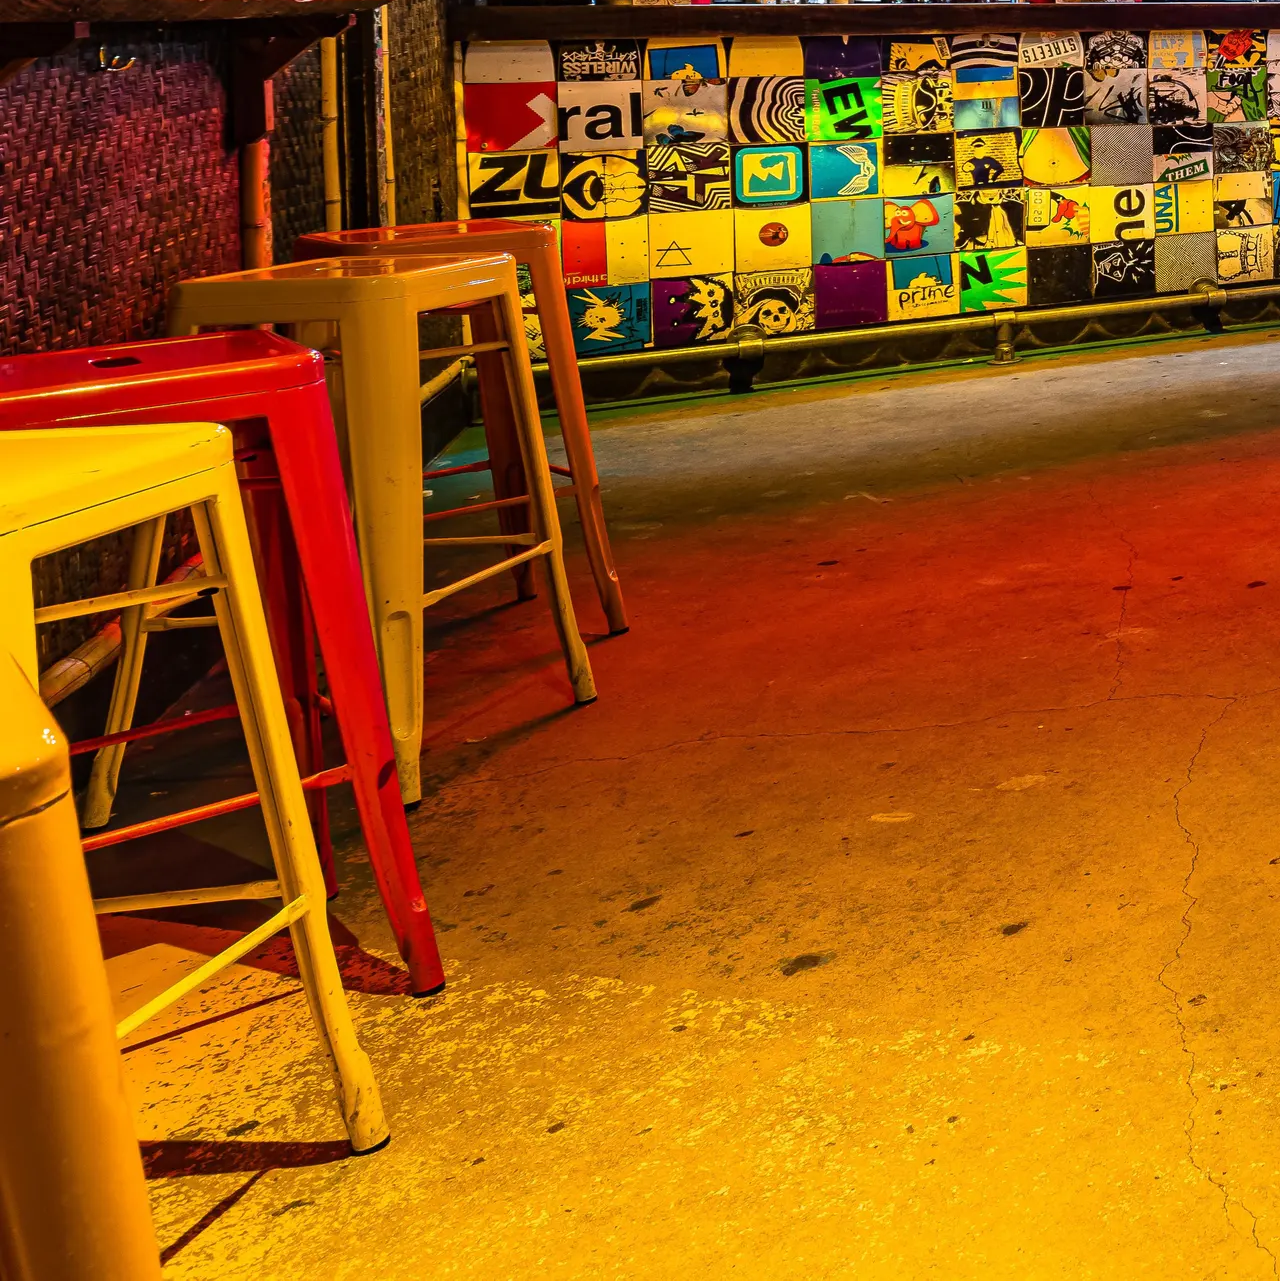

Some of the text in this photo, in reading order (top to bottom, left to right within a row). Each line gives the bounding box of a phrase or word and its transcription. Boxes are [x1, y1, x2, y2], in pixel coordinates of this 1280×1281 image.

[1022, 37, 1078, 64] STREETS
[562, 60, 637, 75] WIRELESS
[1165, 162, 1205, 182] THEM
[570, 273, 597, 284] third
